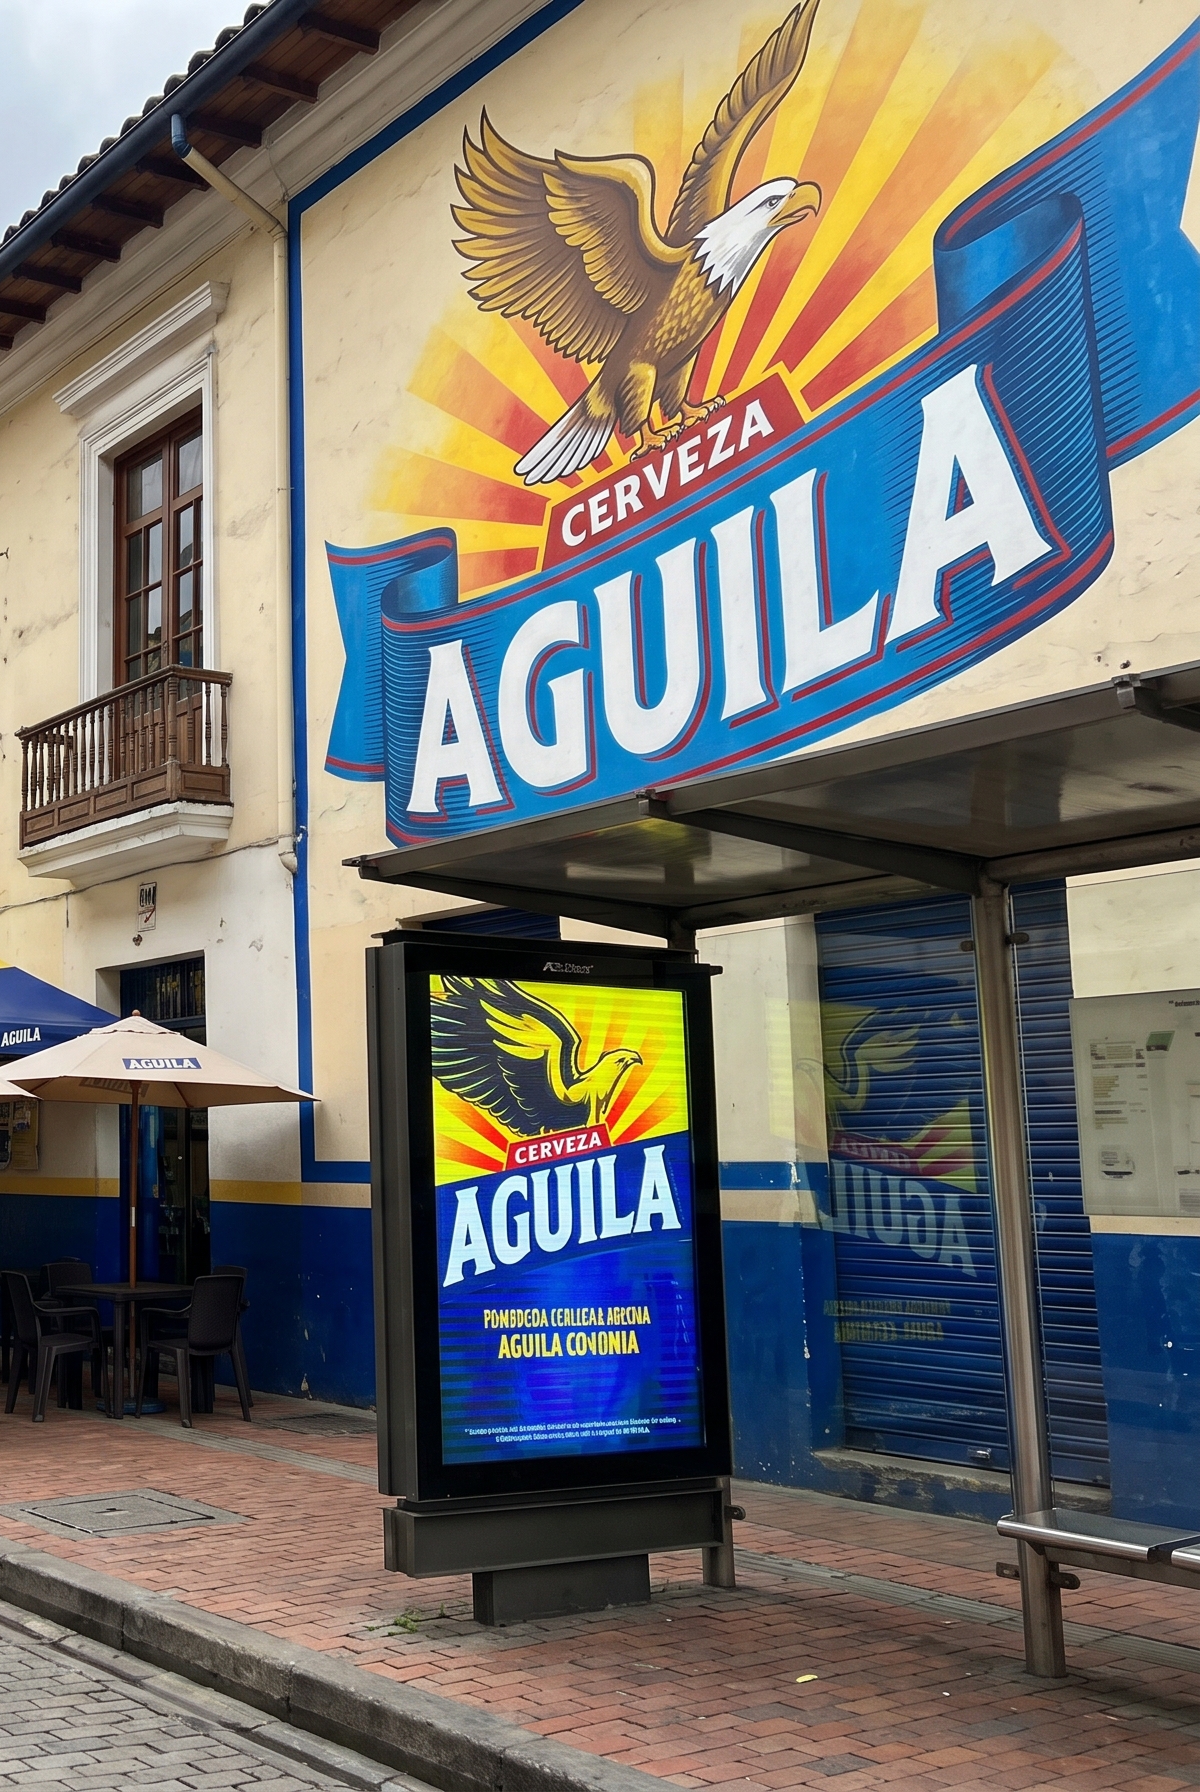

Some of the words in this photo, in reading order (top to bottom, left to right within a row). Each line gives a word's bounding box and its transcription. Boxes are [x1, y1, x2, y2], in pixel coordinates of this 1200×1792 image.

[560, 398, 775, 549] CERVEZA
[404, 362, 1053, 814] AGUILA
[128, 1058, 197, 1070] AGUILA
[514, 1131, 603, 1165] CERVEZA
[442, 1144, 682, 1288] AGUILA
[497, 1332, 564, 1359] AGUILA
